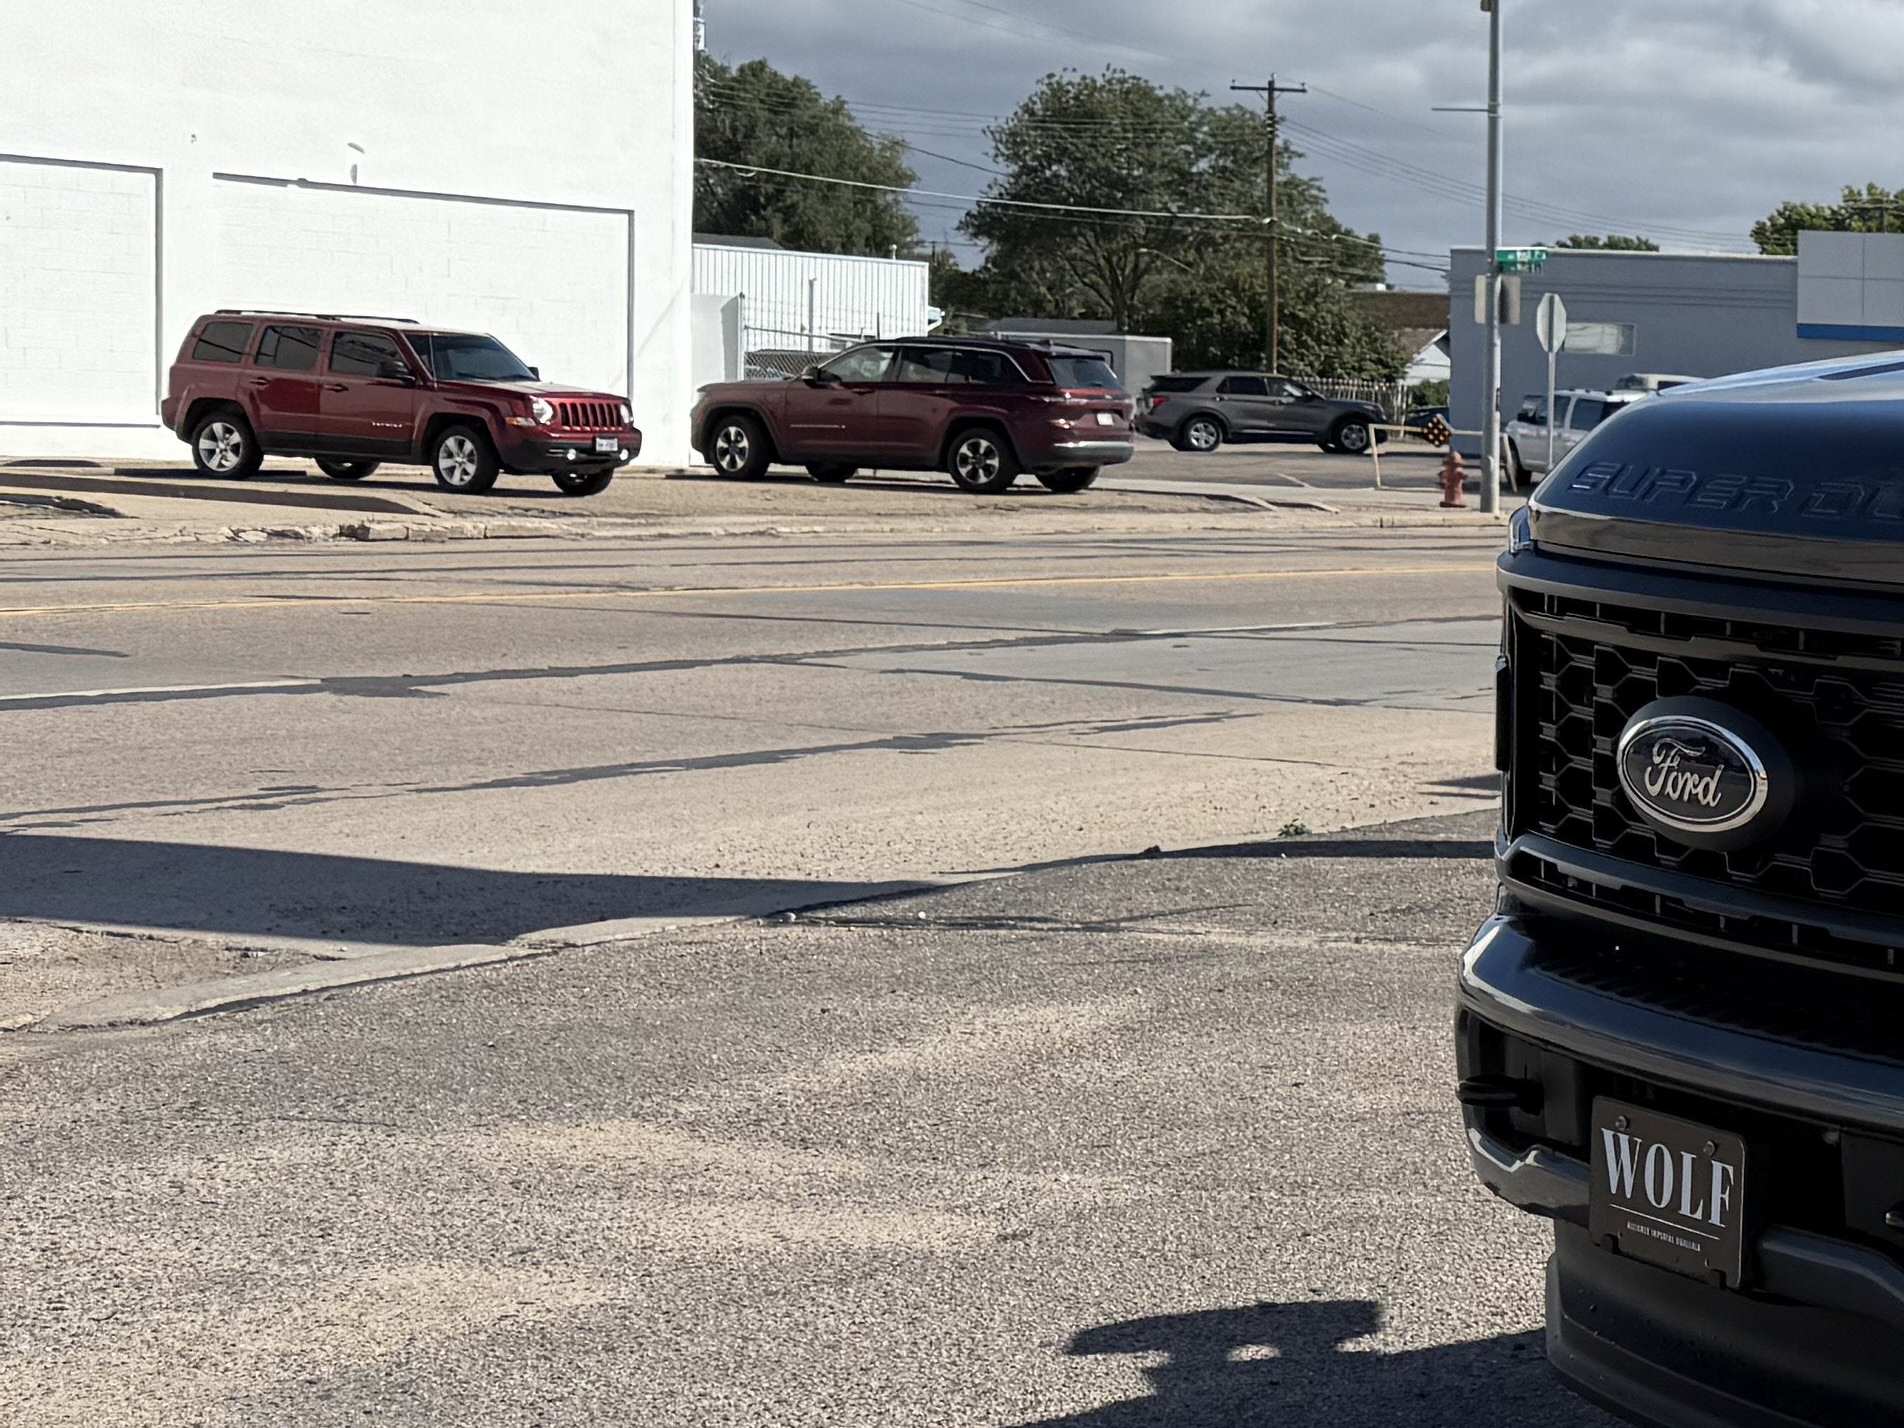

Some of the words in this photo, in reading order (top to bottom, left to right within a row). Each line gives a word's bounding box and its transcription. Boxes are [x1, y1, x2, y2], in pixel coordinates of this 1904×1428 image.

[1566, 461, 1795, 515] SUPER
[1644, 737, 1725, 808] Ford
[1601, 1127, 1735, 1228] WOLF
